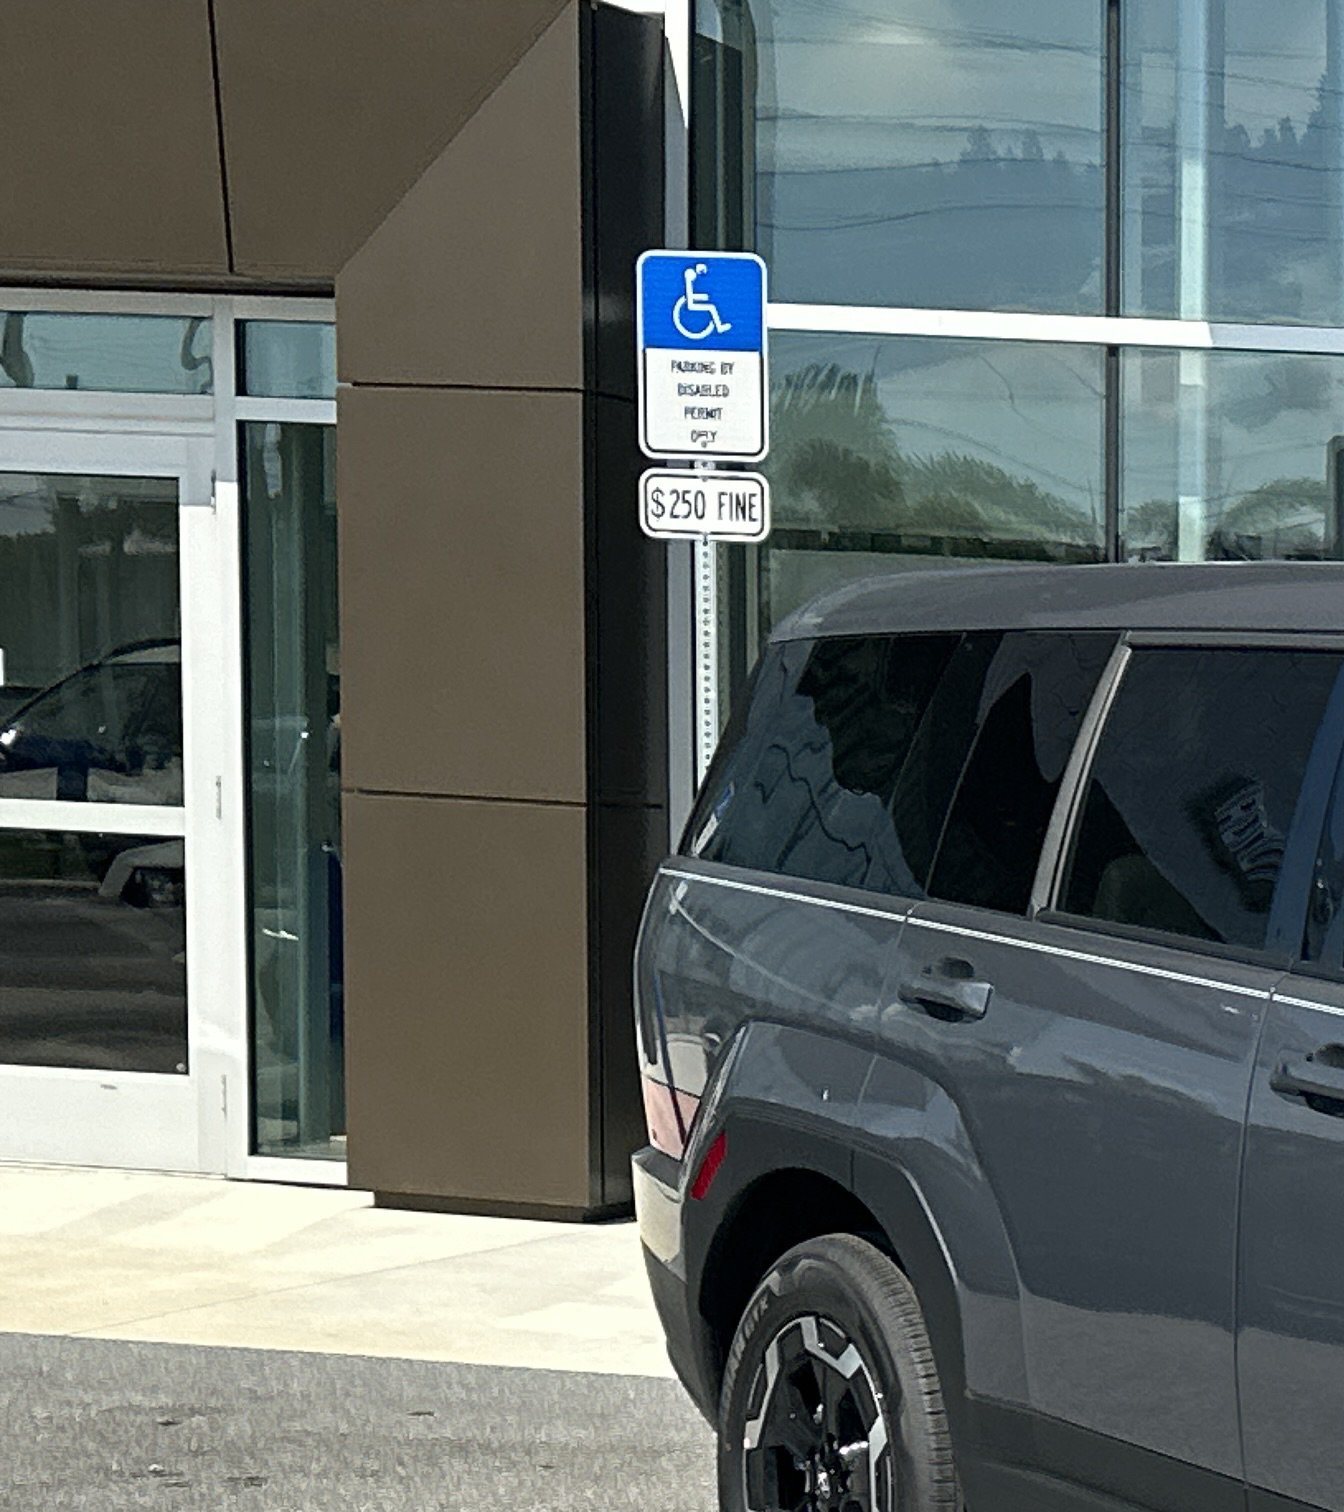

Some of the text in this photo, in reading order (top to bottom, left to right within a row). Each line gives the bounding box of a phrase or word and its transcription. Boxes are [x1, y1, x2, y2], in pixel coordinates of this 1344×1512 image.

[670, 359, 735, 375] PARKING BY
[677, 382, 731, 398] DISABLED
[684, 406, 723, 420] PERMIT
[650, 486, 759, 523] $250 FINE
